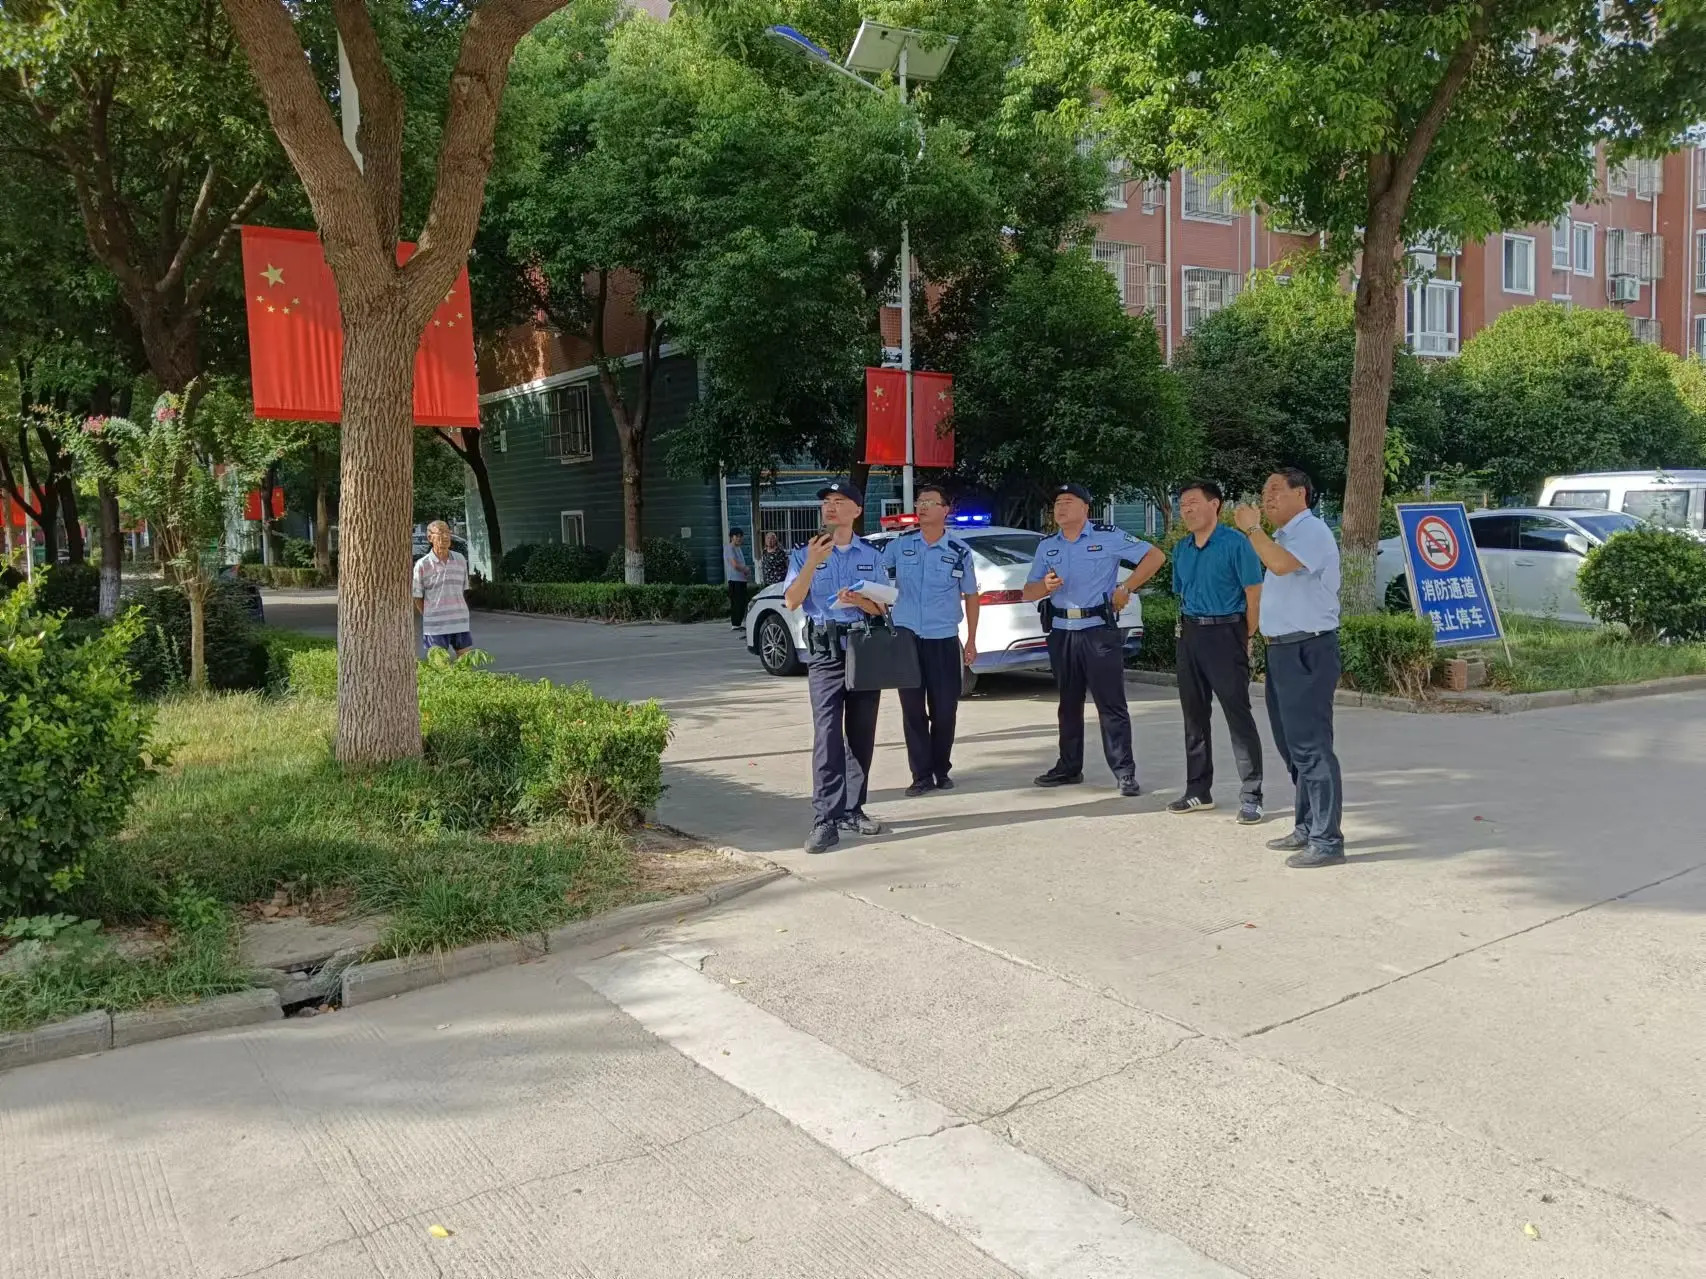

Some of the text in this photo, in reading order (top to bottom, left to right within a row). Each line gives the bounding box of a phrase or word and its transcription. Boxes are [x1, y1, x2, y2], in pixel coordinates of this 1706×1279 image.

[1421, 576, 1478, 602] 消防通道
[1429, 605, 1486, 632] 禁止停车
